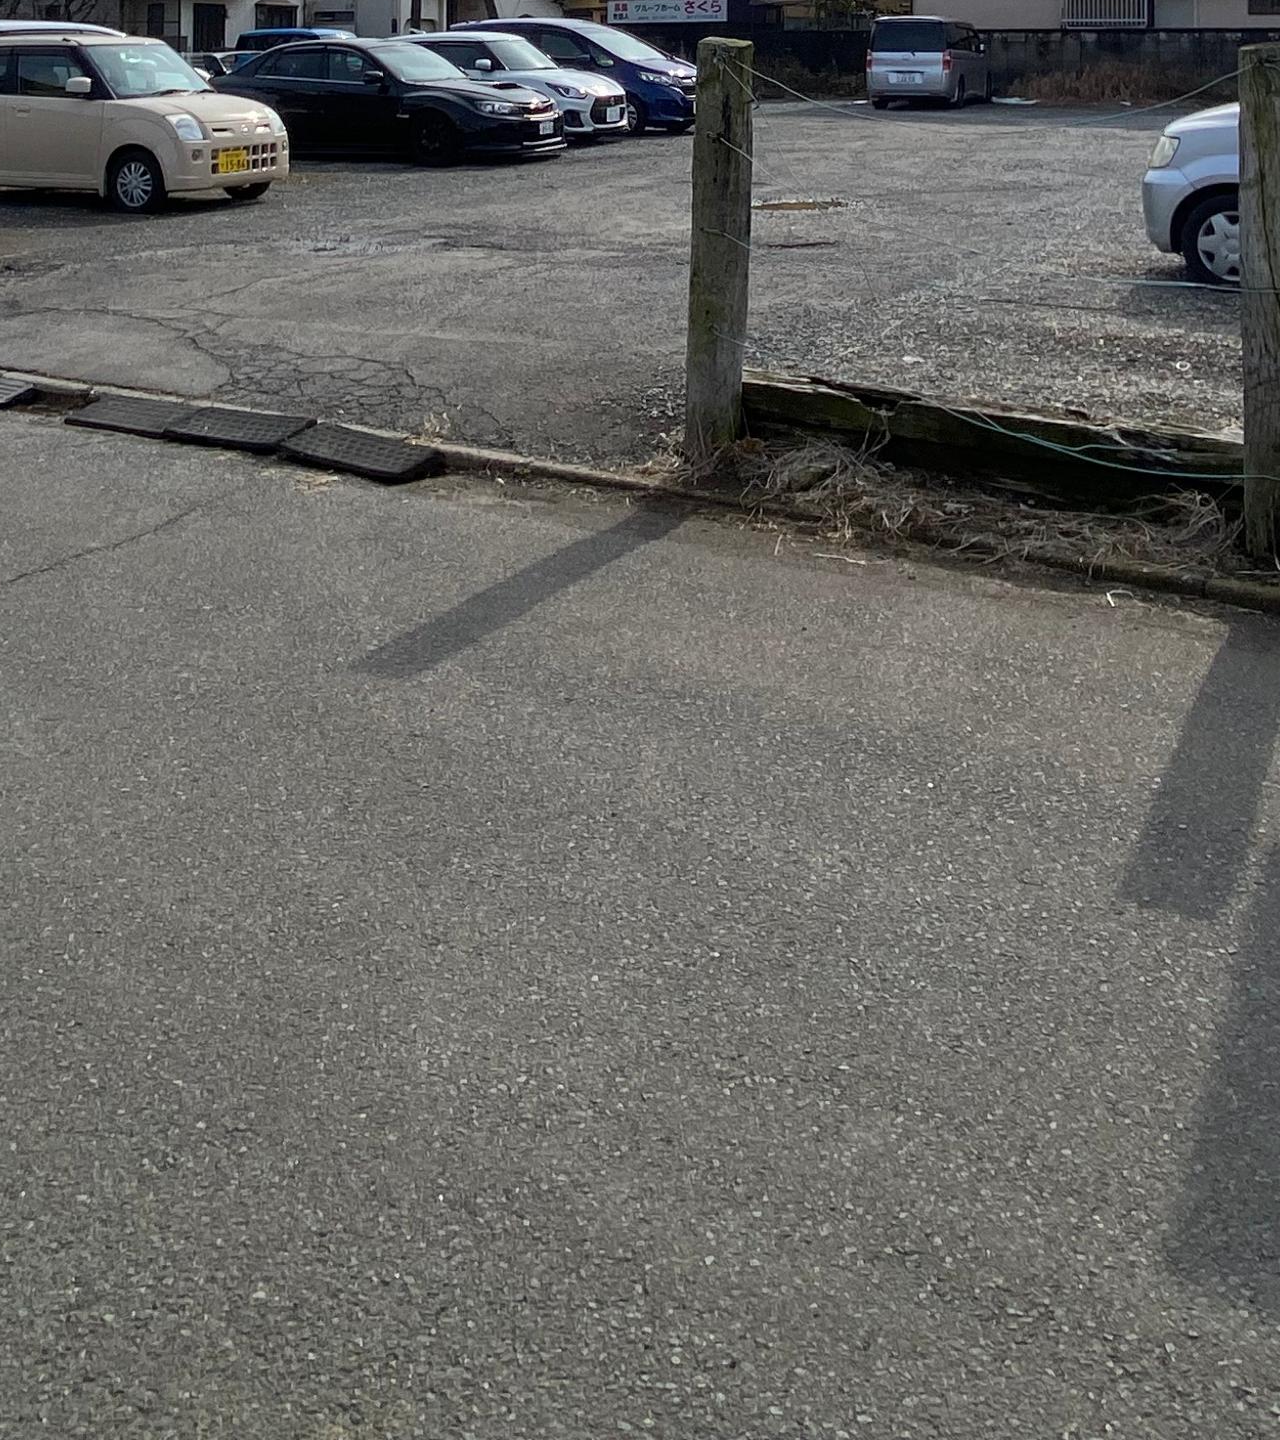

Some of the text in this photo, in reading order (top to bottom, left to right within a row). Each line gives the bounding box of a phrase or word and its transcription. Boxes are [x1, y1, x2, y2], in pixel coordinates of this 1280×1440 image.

[634, 3, 681, 13] グループホーム
[684, 0, 722, 14] さくら
